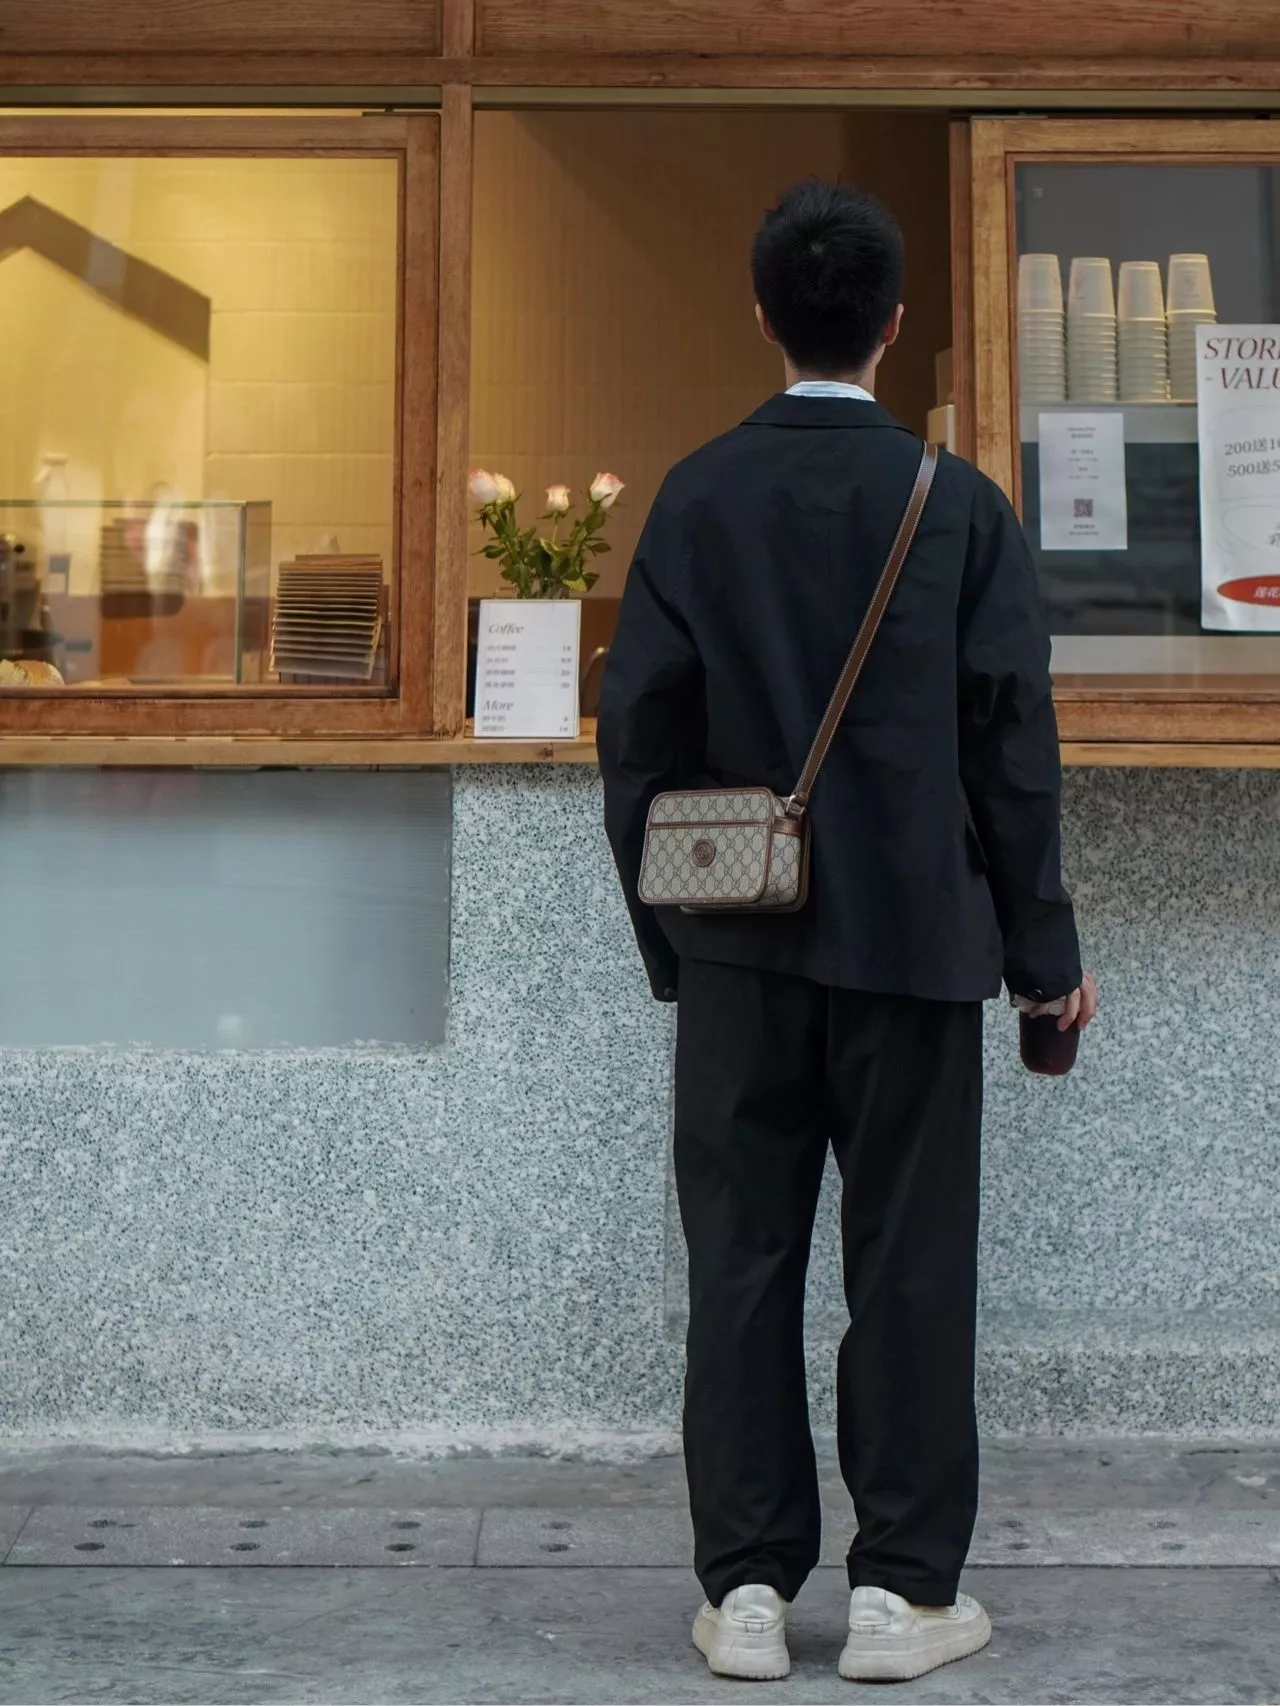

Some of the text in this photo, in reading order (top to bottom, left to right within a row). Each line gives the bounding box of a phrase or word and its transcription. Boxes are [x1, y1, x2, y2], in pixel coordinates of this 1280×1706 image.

[1204, 336, 1280, 360] STOR
[488, 623, 525, 635] Coffee
[483, 700, 514, 711] More
